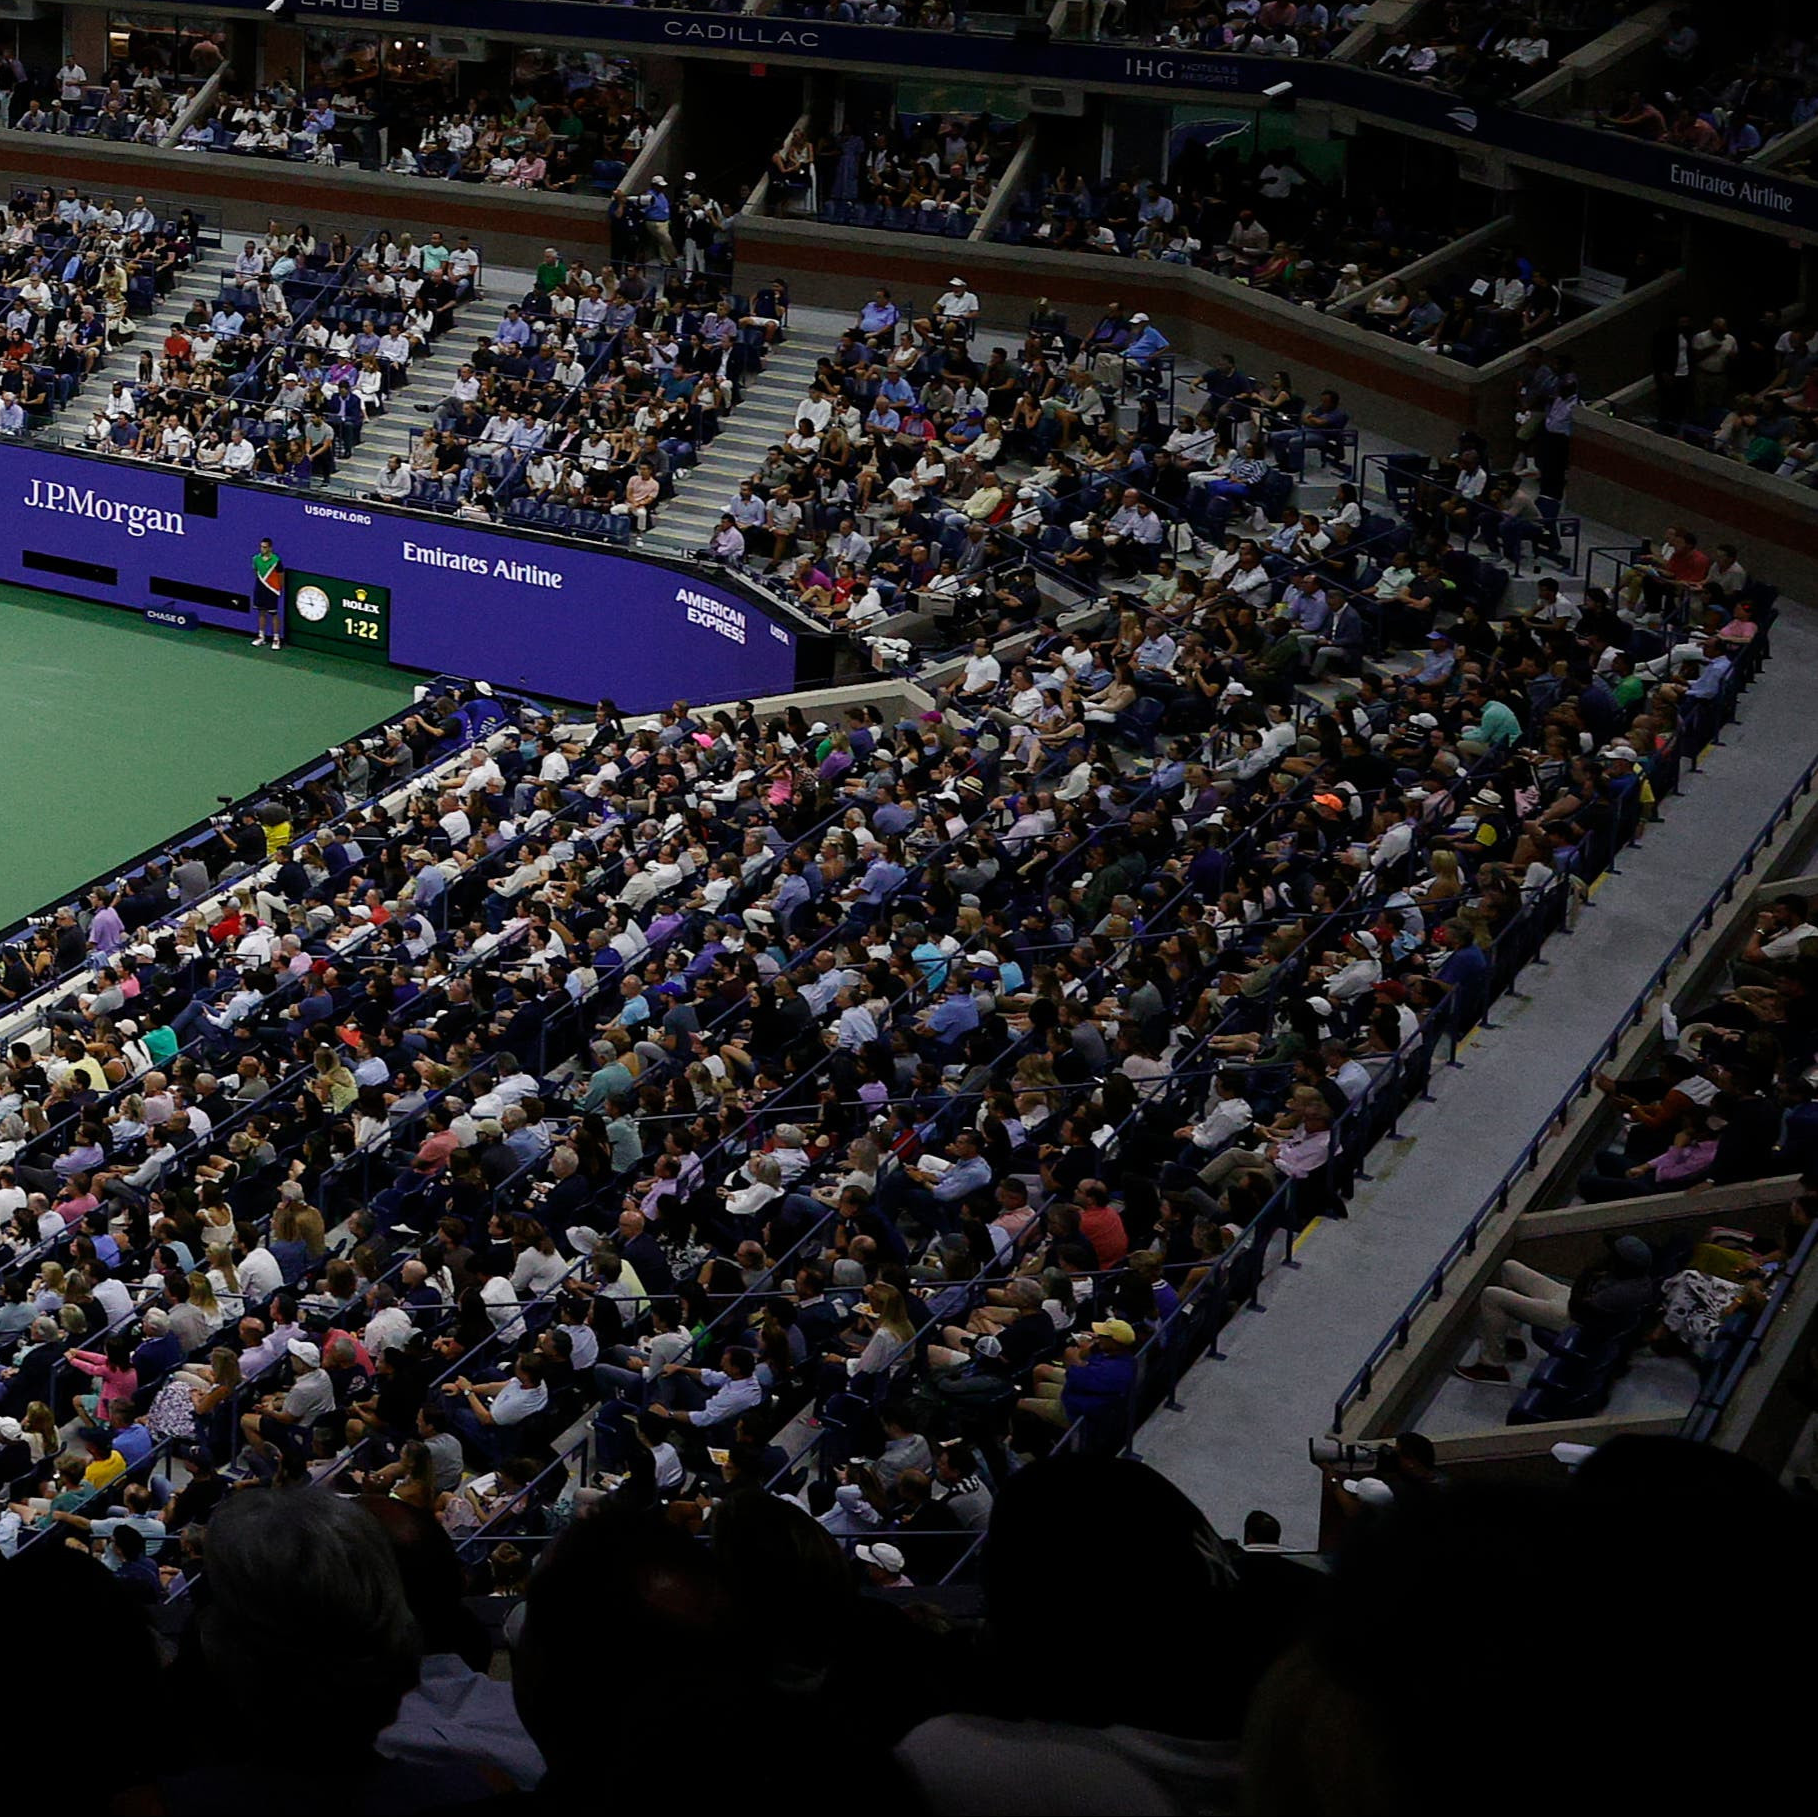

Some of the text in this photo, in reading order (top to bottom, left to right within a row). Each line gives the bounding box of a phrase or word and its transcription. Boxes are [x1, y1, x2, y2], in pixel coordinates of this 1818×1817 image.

[663, 21, 819, 47] CADILLAC
[1125, 58, 1174, 79] IHG
[1669, 163, 1795, 213] Emirates Airline
[24, 479, 184, 538] J.P.Morgan
[304, 505, 372, 525] USOPEN.ORG
[402, 540, 563, 590] Emirates Airline
[342, 599, 380, 614] ROLEX
[675, 588, 746, 629] AMERICAN
[344, 618, 379, 640] 1:22
[686, 607, 746, 645] EXPRESS
